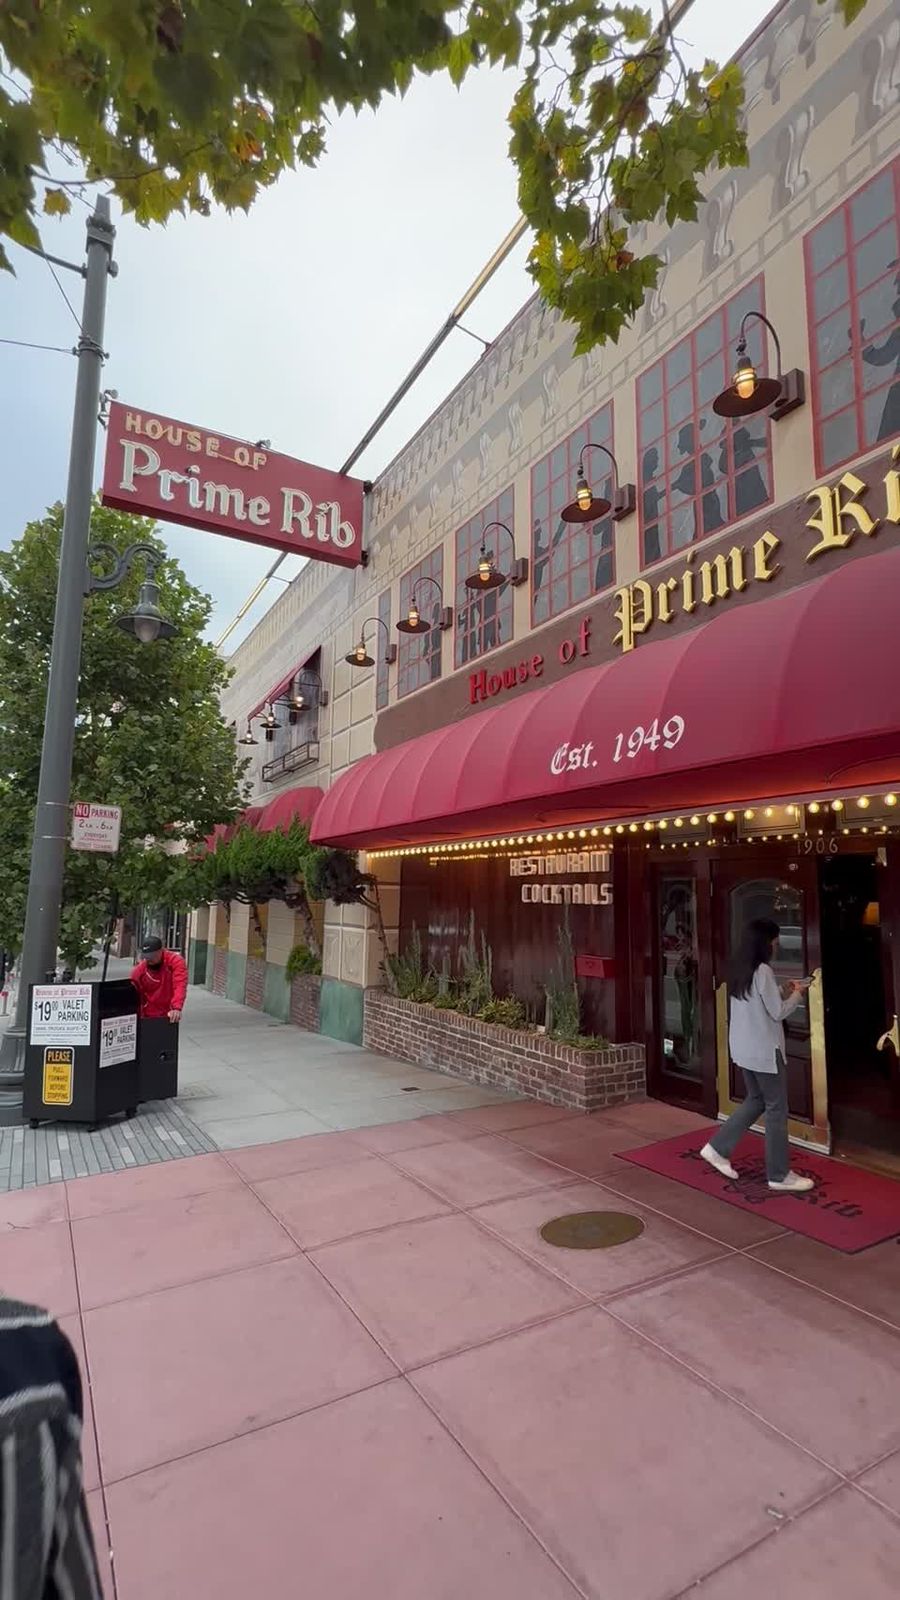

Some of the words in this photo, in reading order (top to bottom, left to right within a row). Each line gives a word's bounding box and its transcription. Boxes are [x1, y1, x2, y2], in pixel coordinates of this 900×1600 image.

[125, 412, 221, 459] HOUSE
[234, 446, 267, 471] OF
[119, 438, 271, 526] Prime
[280, 487, 356, 549] Rib
[468, 651, 544, 705] House
[558, 615, 593, 665] of
[612, 530, 785, 654] Prime
[550, 741, 598, 775] Est.
[612, 714, 686, 764] 1949
[75, 804, 89, 817] NO
[91, 808, 119, 820] PARKING
[797, 837, 839, 855] 1906
[509, 850, 611, 877] RESTAURANT
[521, 883, 614, 905] COCKTAILS
[58, 1010, 89, 1021] PARKING
[63, 999, 85, 1010] VALET
[48, 1050, 71, 1062] PLEASE
